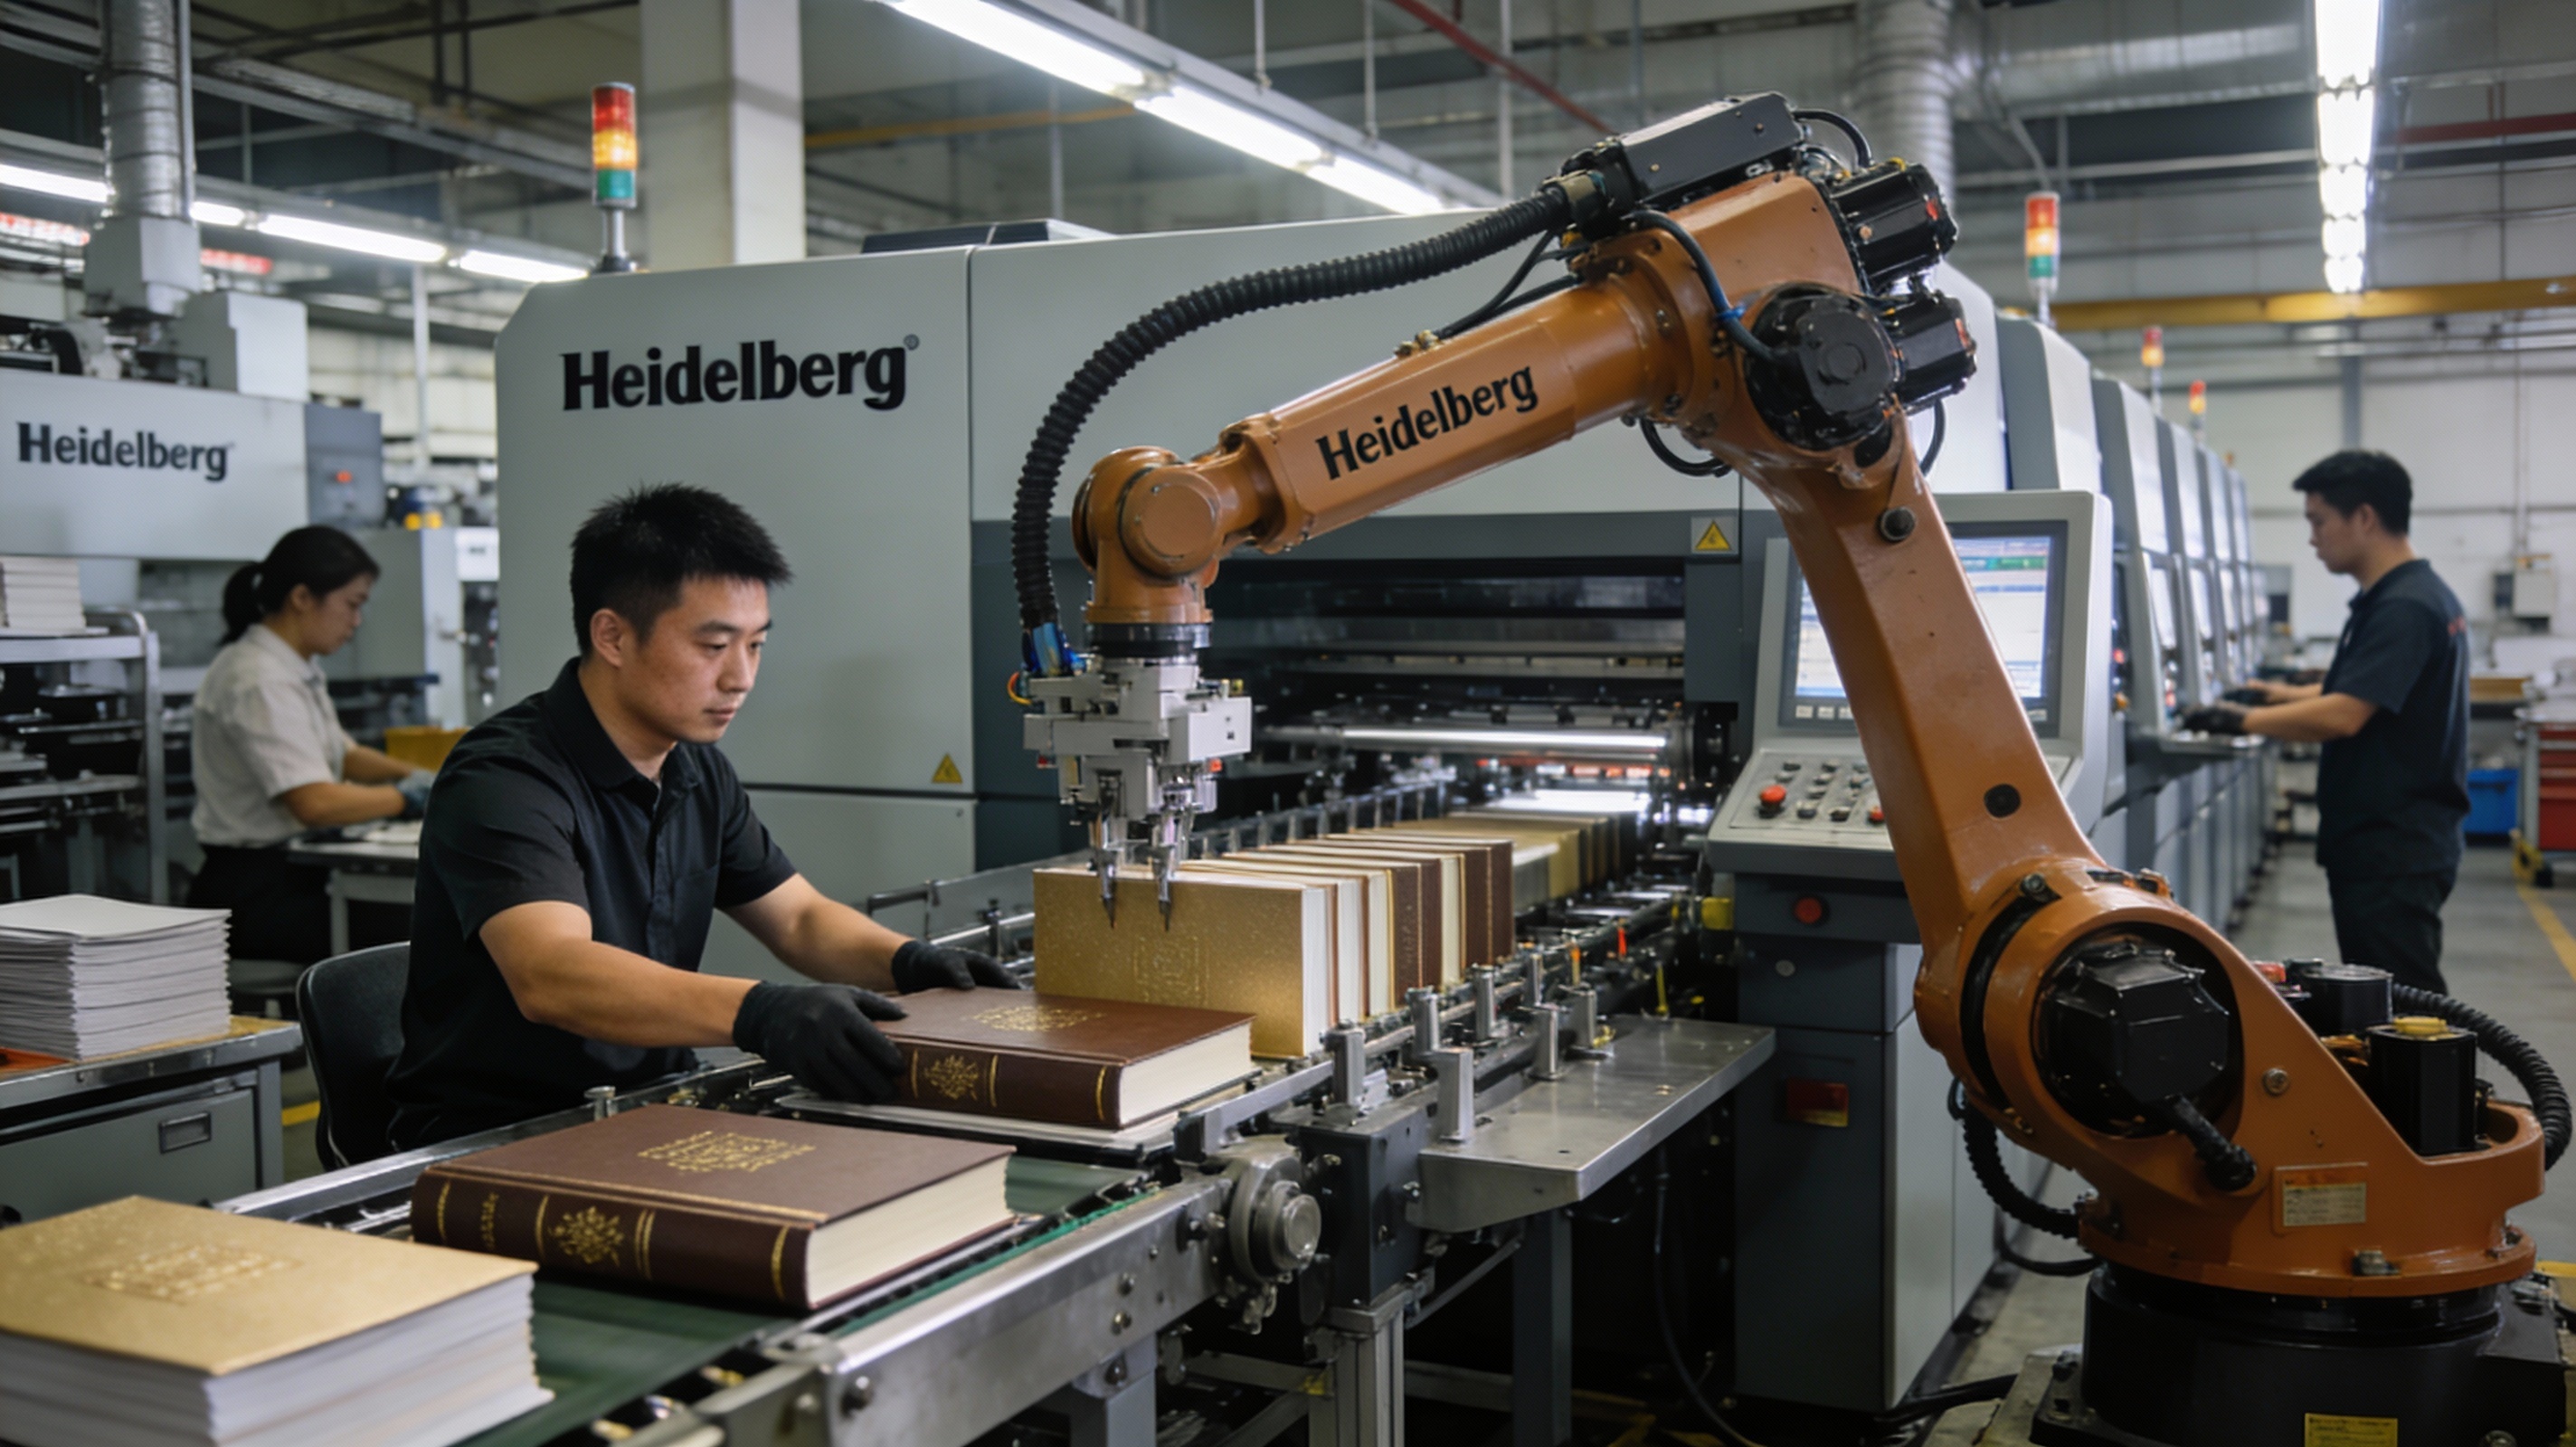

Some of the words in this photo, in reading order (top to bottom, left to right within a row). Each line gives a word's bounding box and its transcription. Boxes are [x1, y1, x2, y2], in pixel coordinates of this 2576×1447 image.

[559, 339, 906, 411] Heidelberg
[17, 421, 227, 483] Heidelberg
[1315, 366, 1539, 481] Heidelberg
